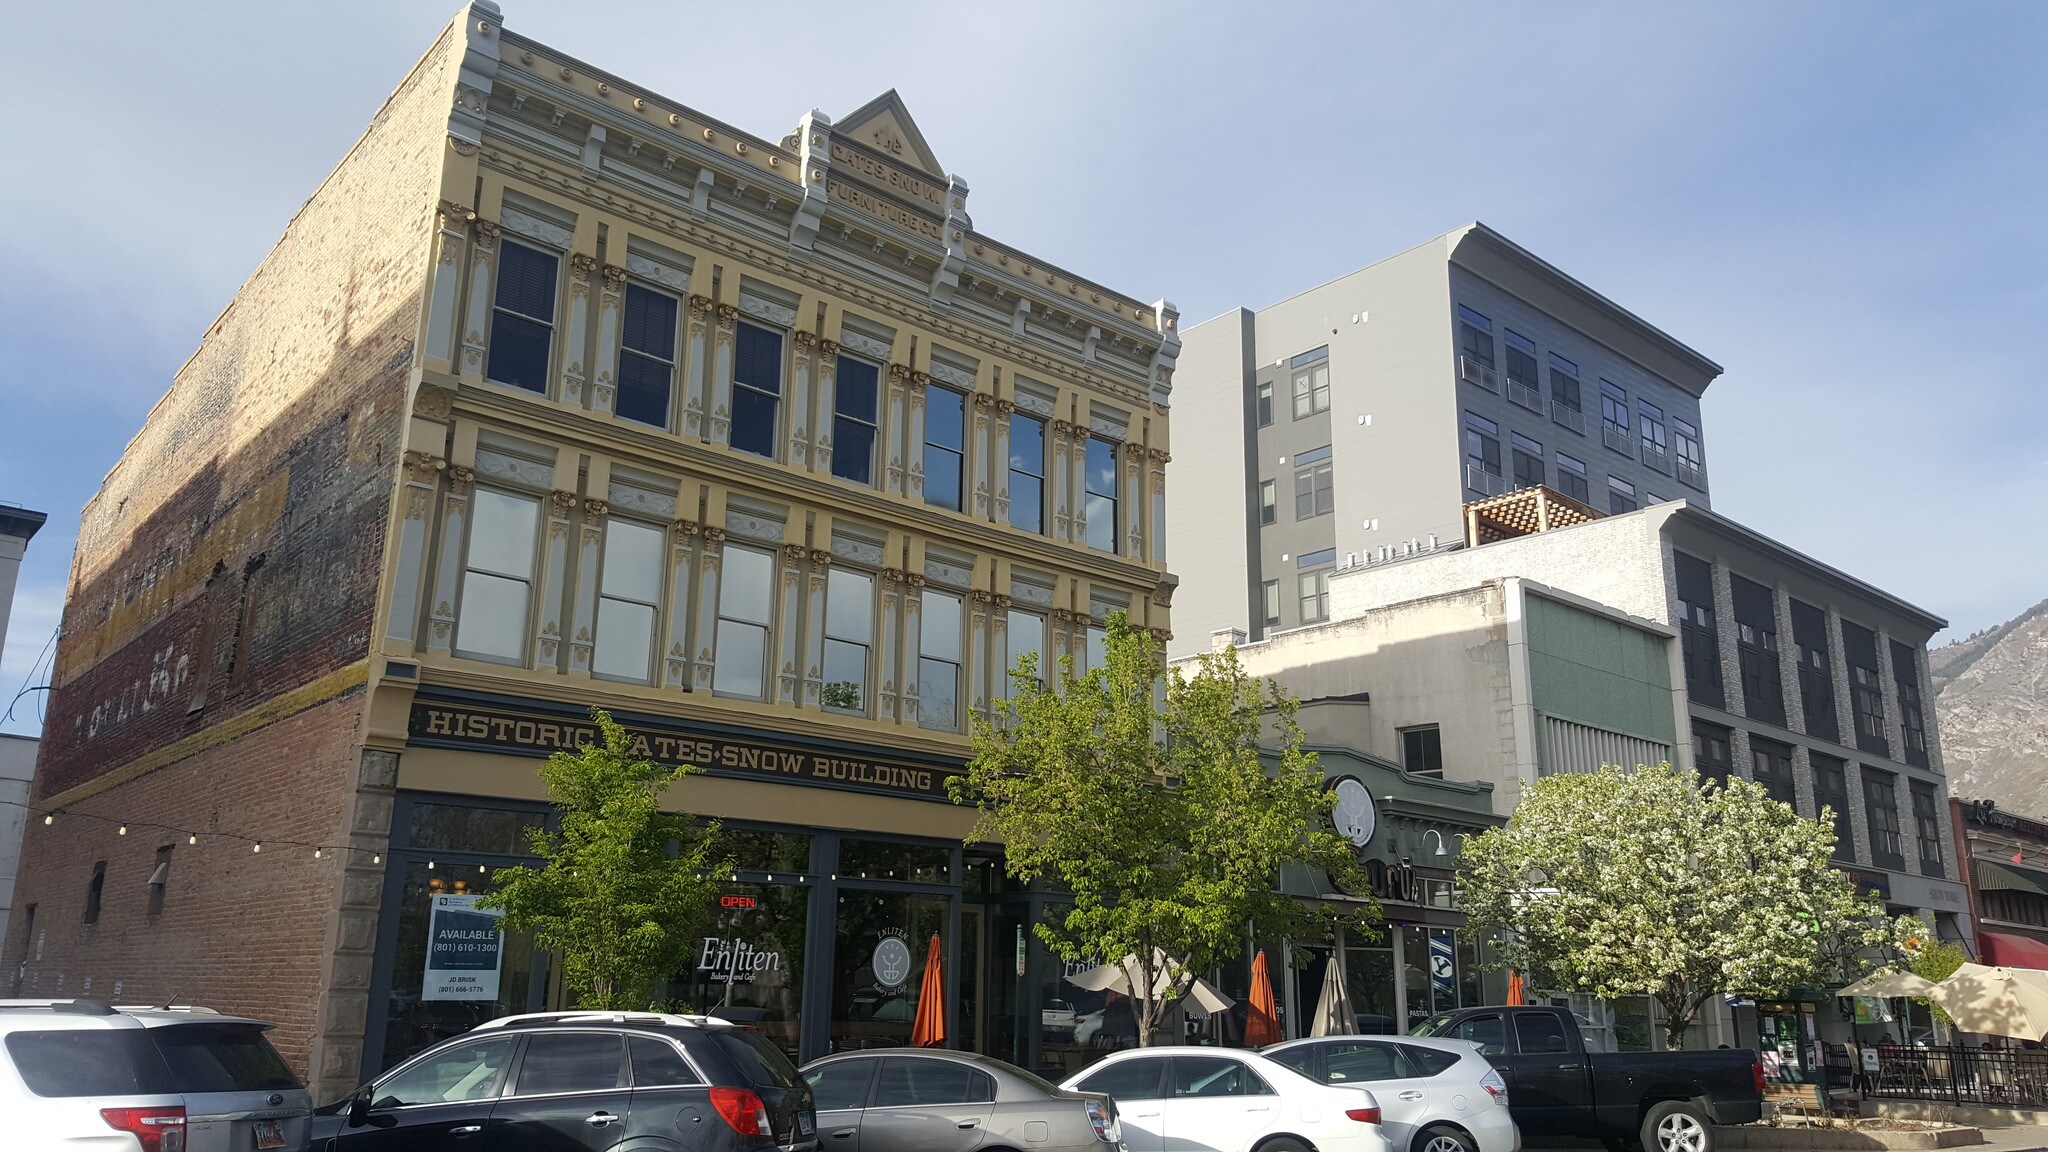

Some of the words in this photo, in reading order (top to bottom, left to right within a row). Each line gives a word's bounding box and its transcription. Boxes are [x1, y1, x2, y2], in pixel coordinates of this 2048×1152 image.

[426, 710, 595, 749] HISTORIC
[812, 757, 932, 790] BUILDING
[721, 896, 755, 907] OPEN
[439, 929, 495, 939] AVAILABLE
[877, 927, 909, 940] ENLITEN
[434, 942, 456, 953] (801)
[457, 943, 497, 952] 610-1300
[697, 937, 779, 985] Enliten
[710, 971, 729, 982] Bakery
[733, 972, 744, 981] and
